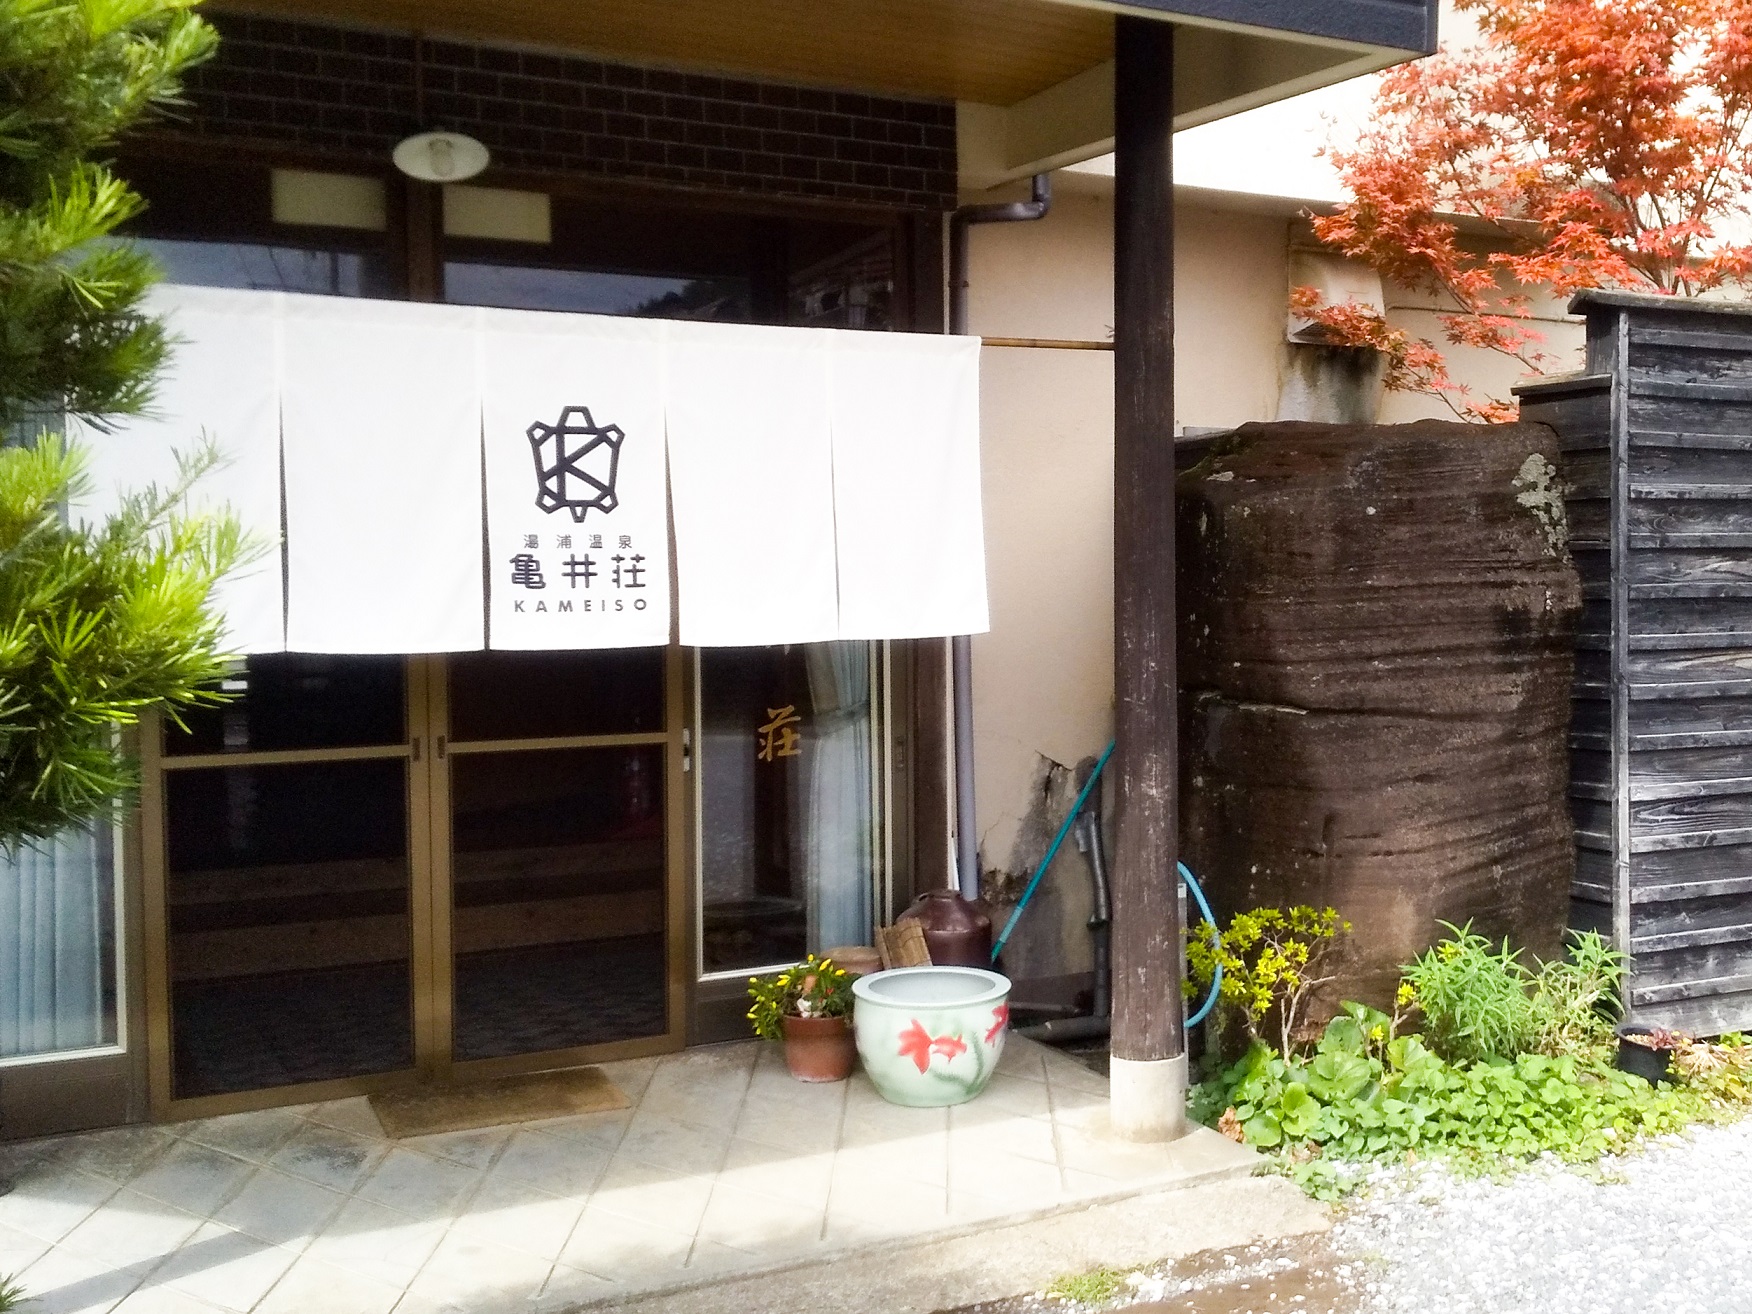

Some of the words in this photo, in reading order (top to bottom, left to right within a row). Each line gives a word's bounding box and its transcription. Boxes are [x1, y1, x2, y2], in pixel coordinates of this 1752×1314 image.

[509, 553, 646, 590] 亀井荘
[515, 599, 647, 612] KAMEISO
[758, 705, 802, 762] 荘
